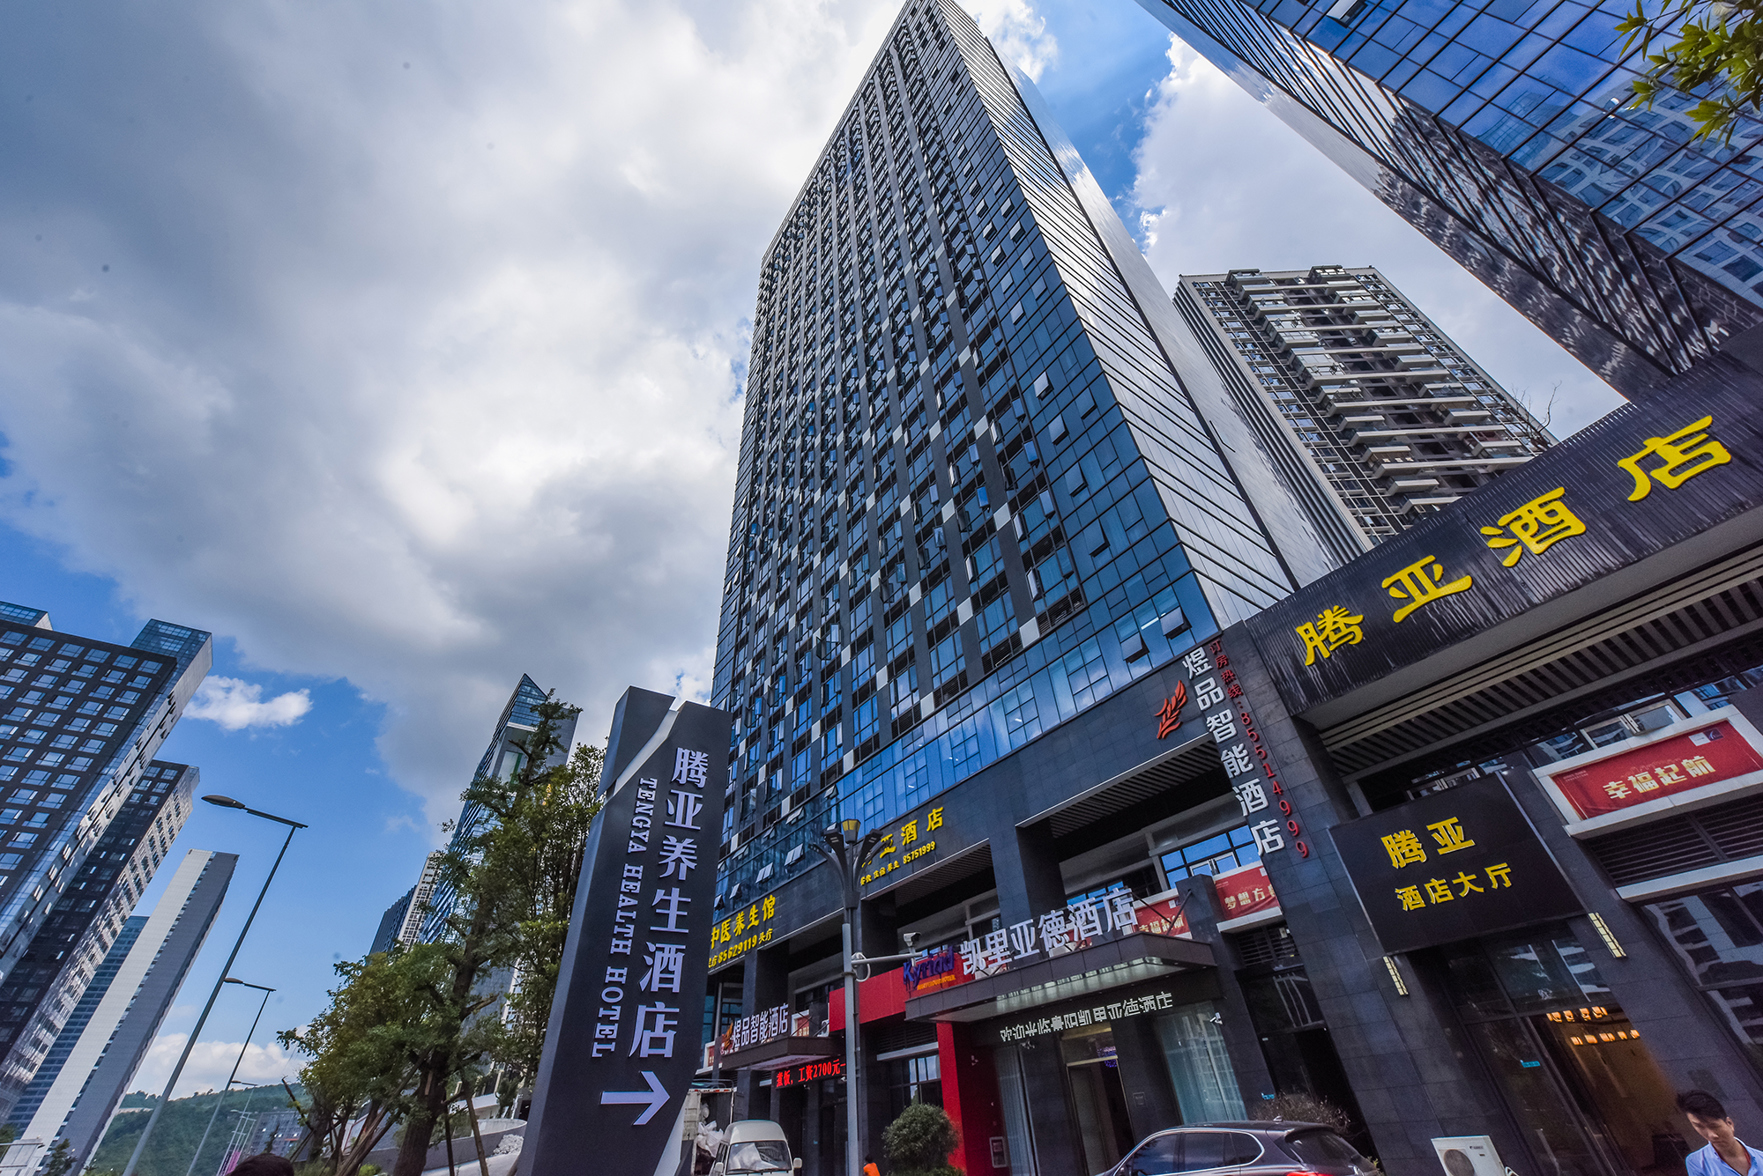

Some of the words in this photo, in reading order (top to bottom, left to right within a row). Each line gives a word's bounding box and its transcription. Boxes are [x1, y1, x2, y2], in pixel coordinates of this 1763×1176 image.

[1296, 414, 1732, 666] 腾亚酒店
[1182, 646, 1285, 857] 煜品智能酒店
[1602, 754, 1717, 800] 幸福起航
[627, 777, 658, 854] TENGYA
[861, 806, 944, 868] 亚酒店
[1380, 816, 1476, 870] 腾亚
[609, 862, 644, 956] HEALTH
[628, 746, 709, 1059] 腾亚养生酒店
[710, 894, 776, 950] 中医养生馆
[1394, 861, 1512, 912] 酒店大厅
[959, 887, 1139, 976] 凯里亚德酒店
[591, 965, 628, 1058] HOTEL
[731, 1003, 789, 1048] 煜品智能酒店
